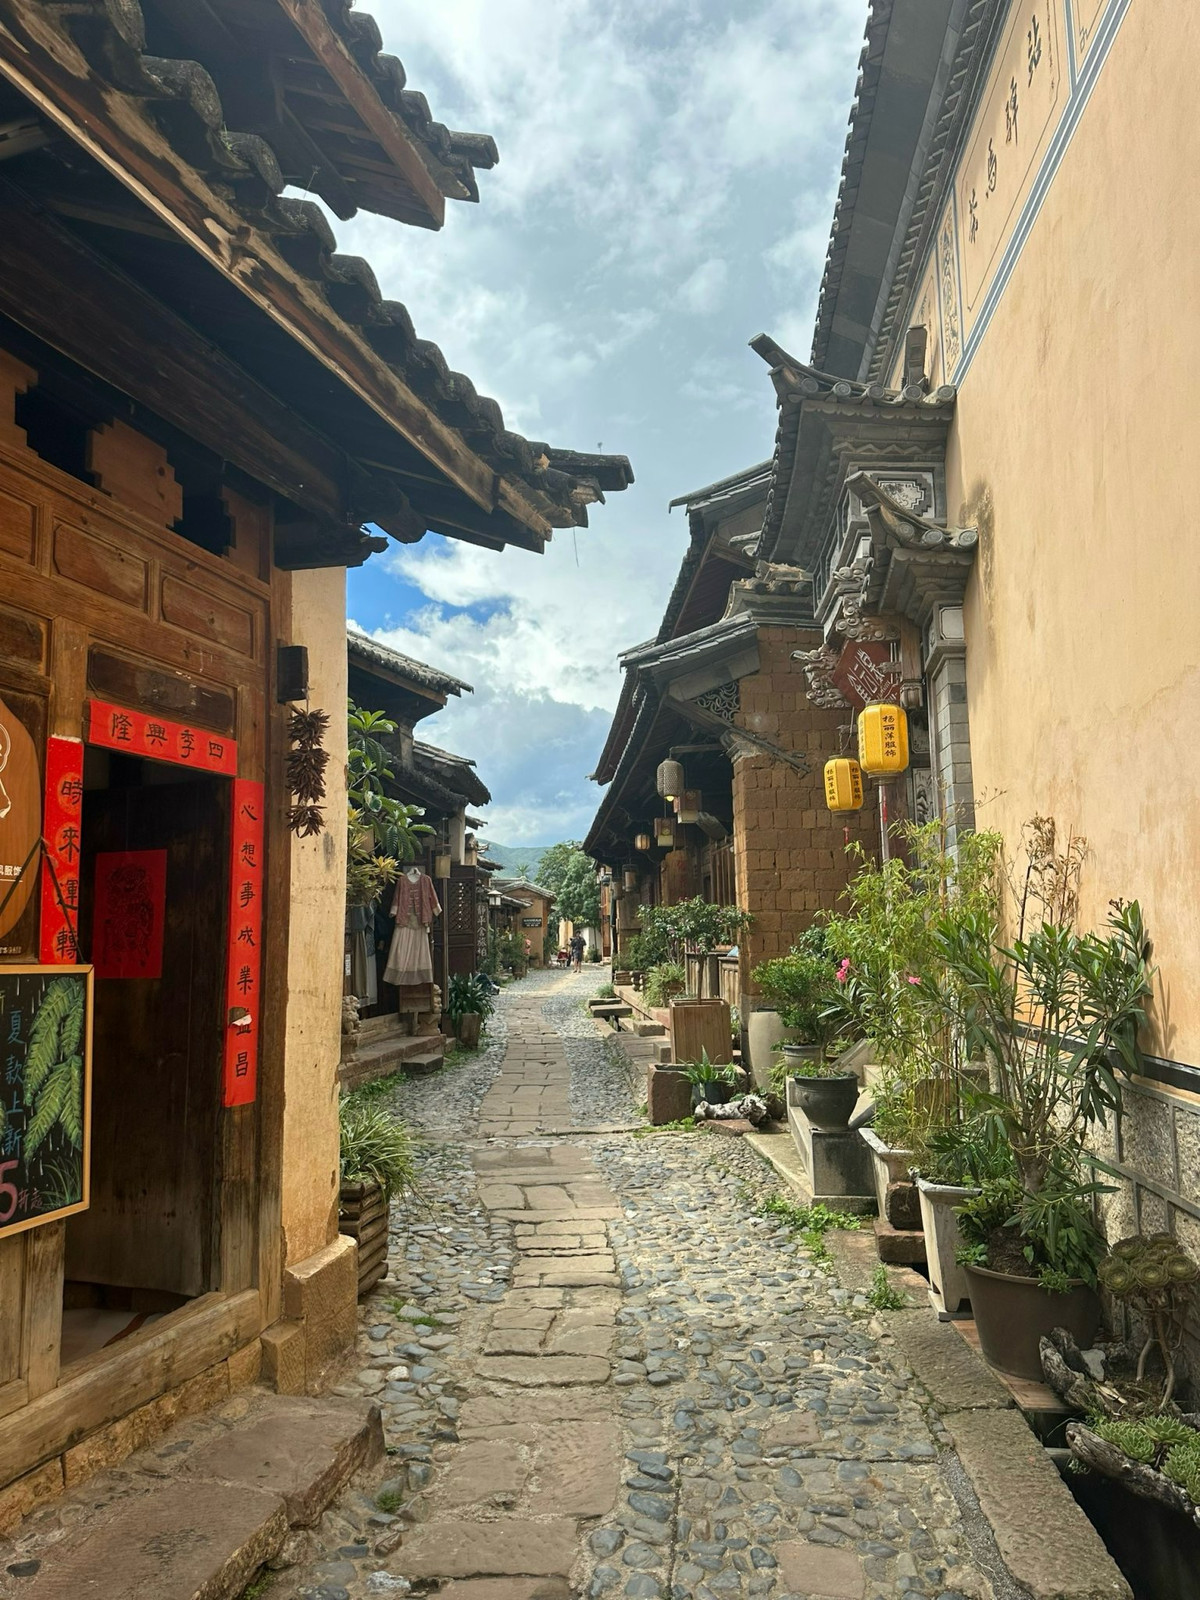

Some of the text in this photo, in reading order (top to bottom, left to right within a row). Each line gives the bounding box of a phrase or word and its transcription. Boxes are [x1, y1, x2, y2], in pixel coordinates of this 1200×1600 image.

[56, 780, 83, 959] 時來運轉
[4, 1010, 25, 1158] 夏款上新
